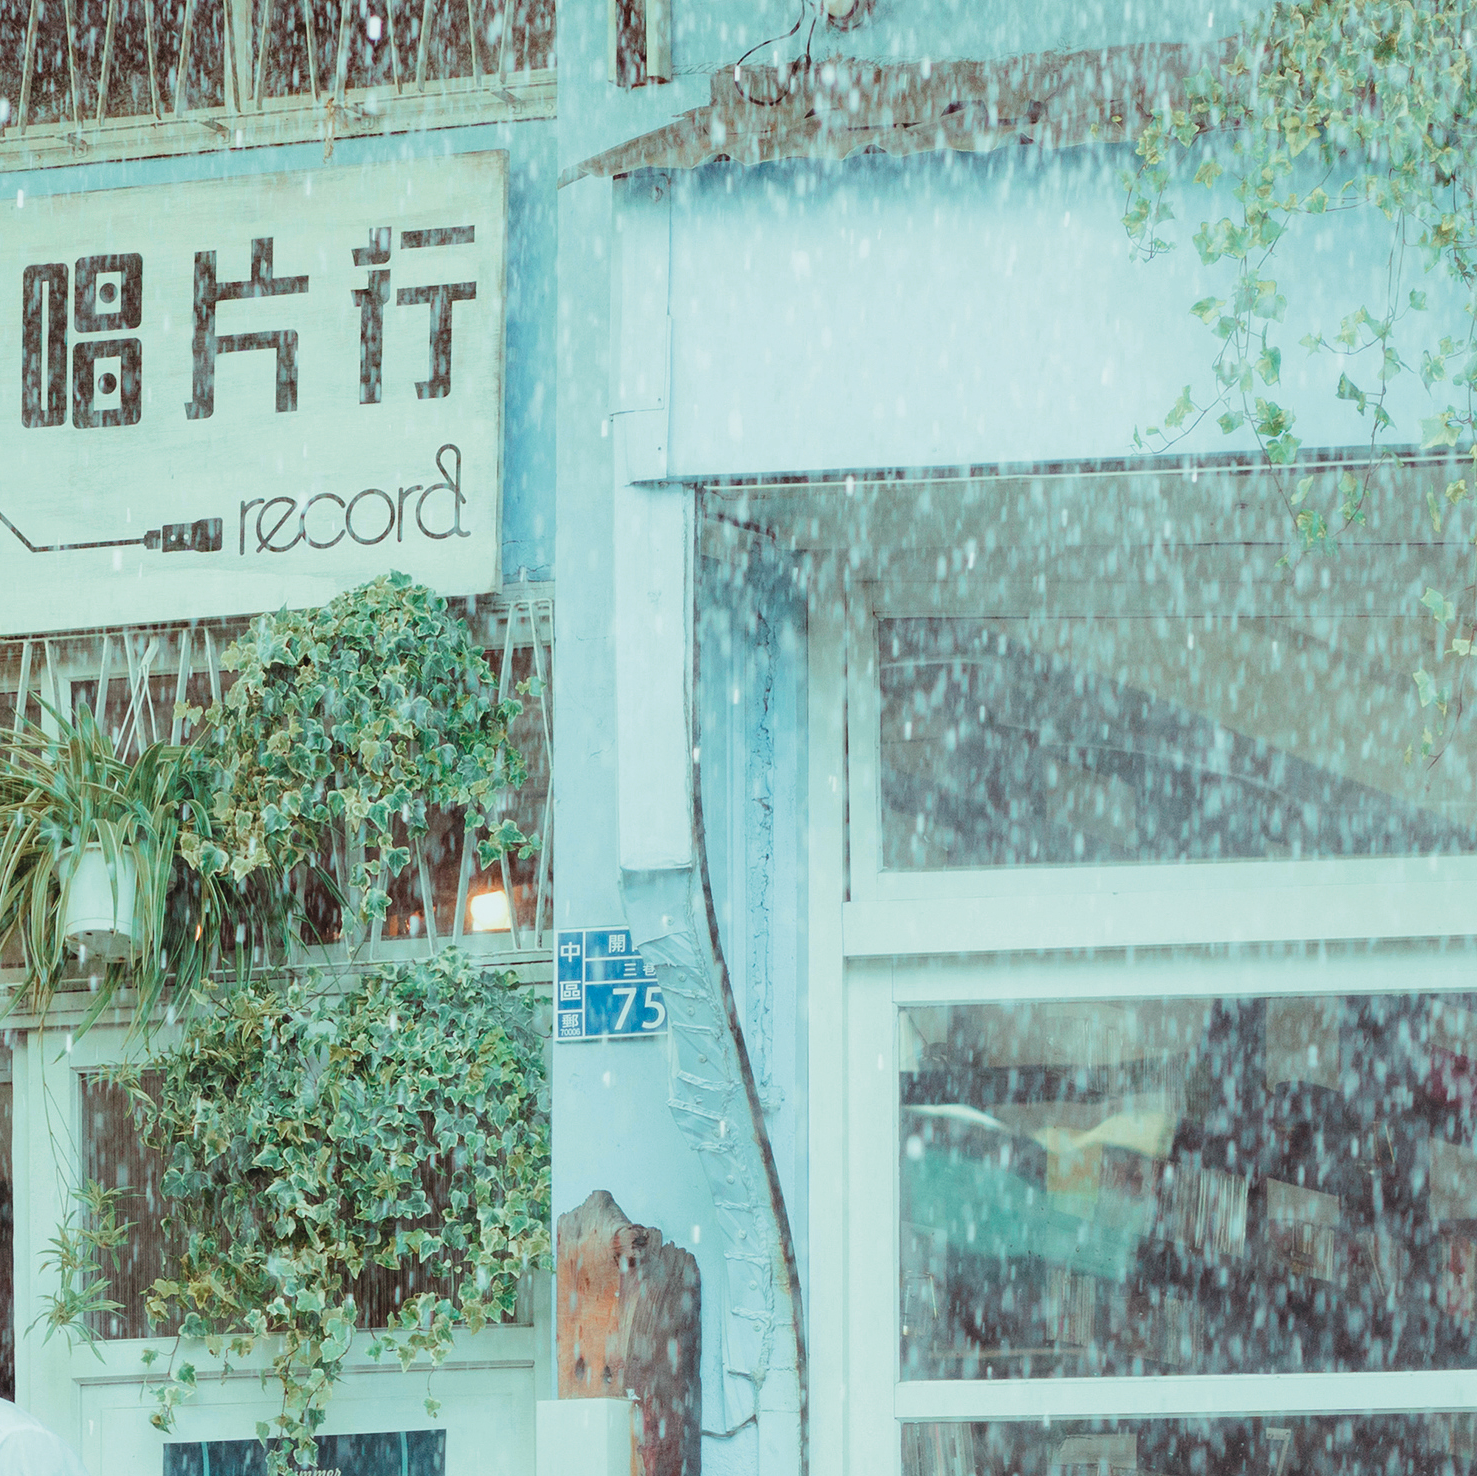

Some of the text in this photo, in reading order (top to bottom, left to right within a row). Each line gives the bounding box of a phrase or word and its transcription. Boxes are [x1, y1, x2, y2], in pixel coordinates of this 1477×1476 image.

[21, 225, 477, 429] 唱片行
[239, 443, 470, 555] record
[608, 934, 638, 953] 開
[560, 941, 581, 1001] 中區
[561, 1013, 579, 1029] 郵
[612, 986, 666, 1031] 75
